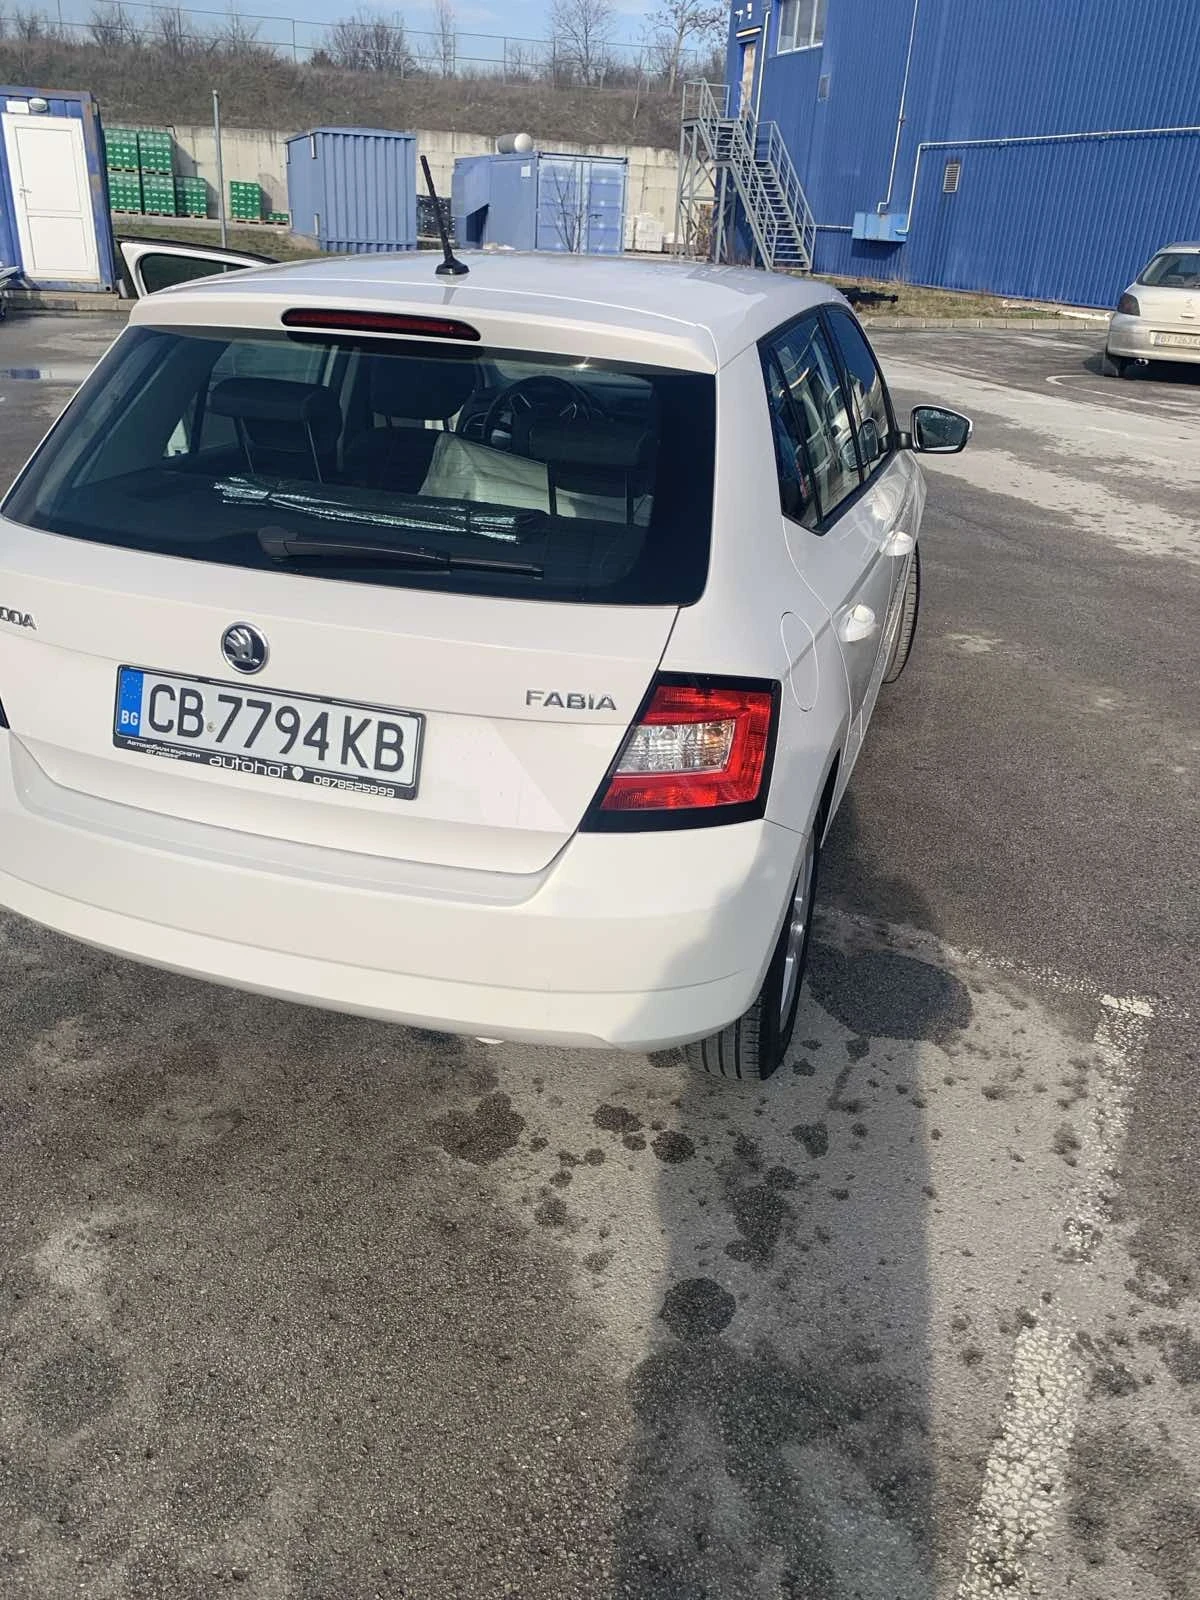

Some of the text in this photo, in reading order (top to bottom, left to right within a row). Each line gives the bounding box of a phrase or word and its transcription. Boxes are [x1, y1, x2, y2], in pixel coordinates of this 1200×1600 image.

[526, 689, 617, 711] FABIA
[121, 709, 139, 726] BG
[148, 683, 405, 773] CB 7794 KB
[208, 755, 288, 779] autohof
[313, 775, 395, 798] 0878525999
